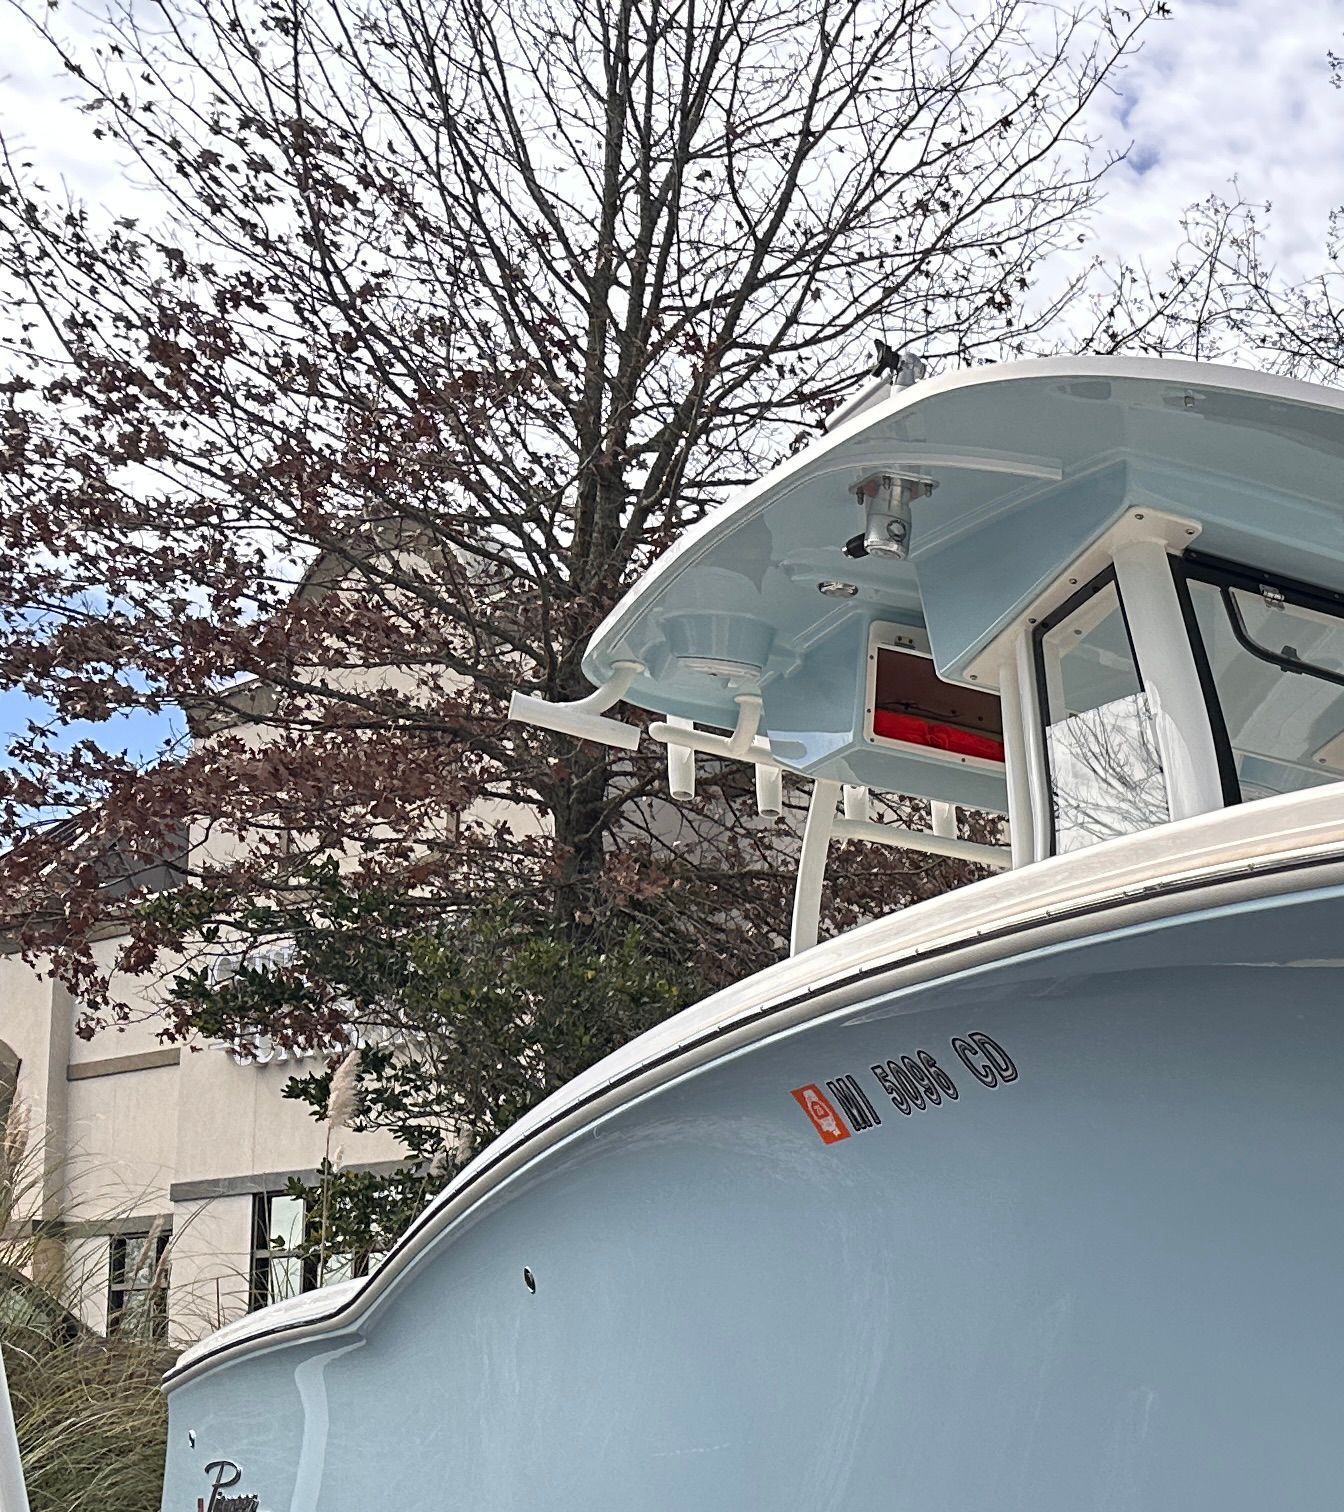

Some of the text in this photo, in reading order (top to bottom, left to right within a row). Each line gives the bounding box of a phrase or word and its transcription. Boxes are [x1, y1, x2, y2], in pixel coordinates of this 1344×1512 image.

[826, 1031, 1018, 1132] MI 5096 CD
